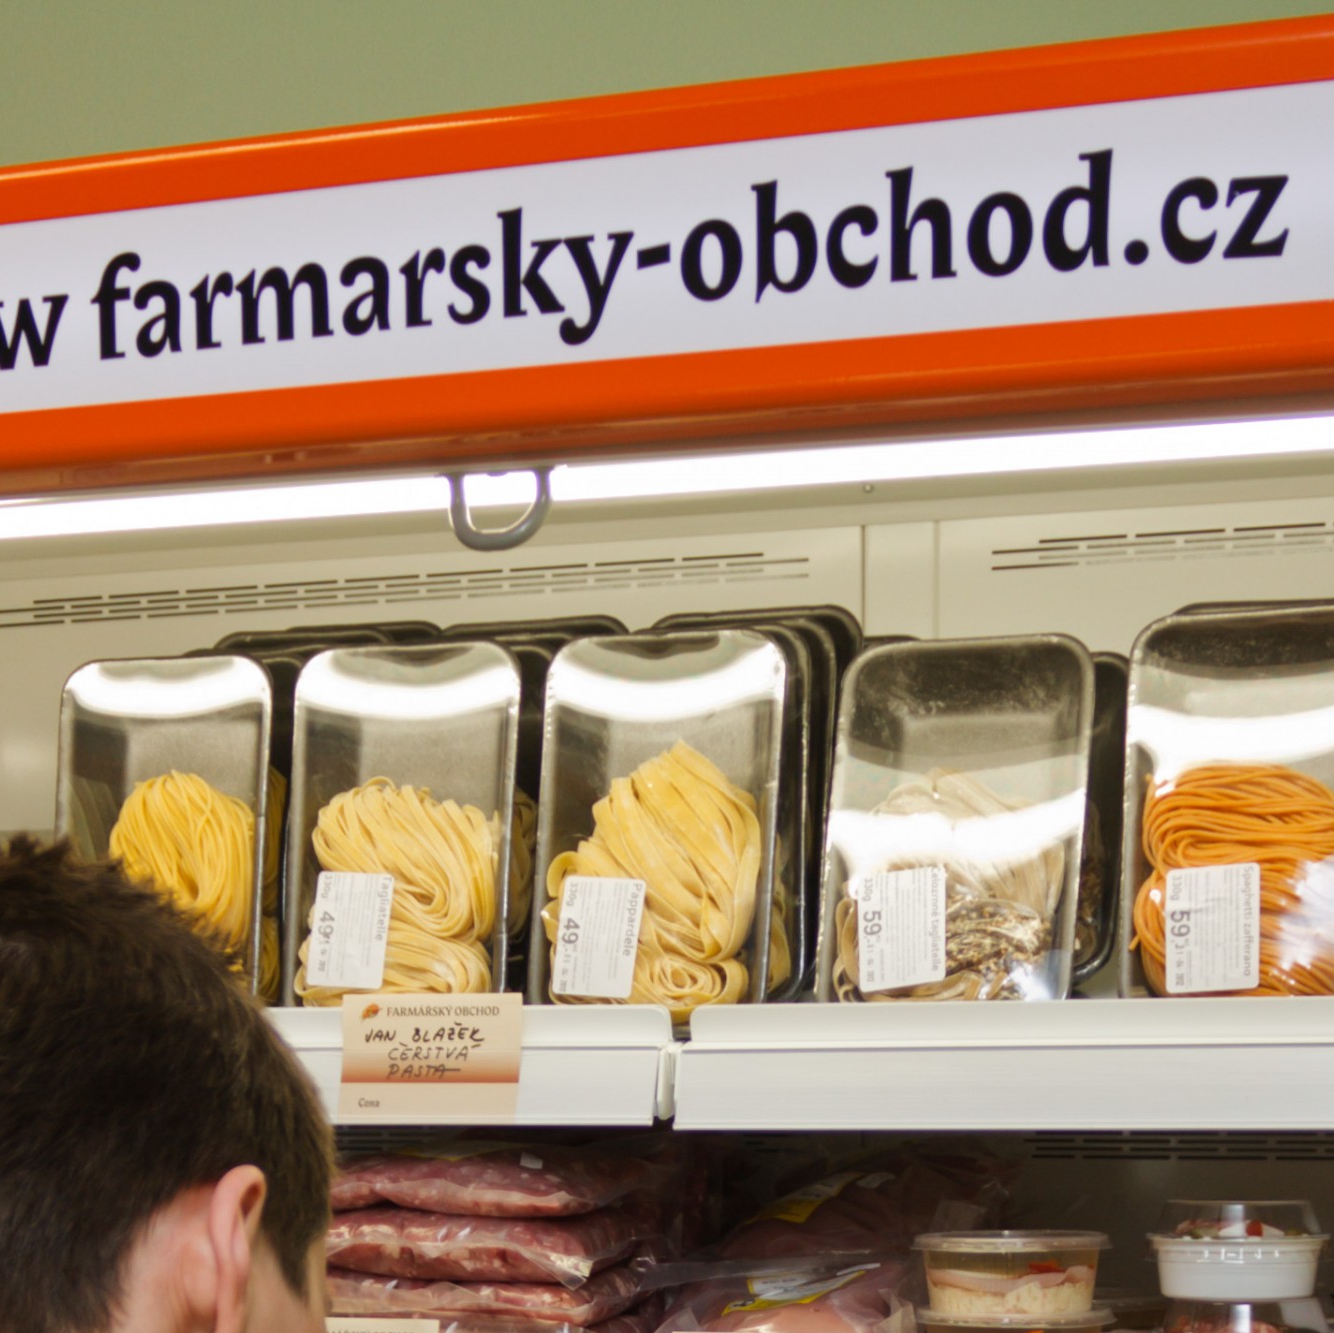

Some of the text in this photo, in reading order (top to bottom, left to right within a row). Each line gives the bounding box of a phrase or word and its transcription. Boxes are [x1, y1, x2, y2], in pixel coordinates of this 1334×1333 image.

[91, 148, 1290, 360] farmarsky-obchod.cz
[375, 877, 392, 941] Tagliatelle
[623, 883, 642, 956] Pappardele
[1242, 866, 1254, 976] Spaghetti zafferano
[387, 1004, 499, 1017] FARMÁŘSKÝ OBCHOD
[365, 1029, 397, 1043] JAN
[387, 1063, 461, 1080] PASTA
[358, 1098, 380, 1108] Cena
